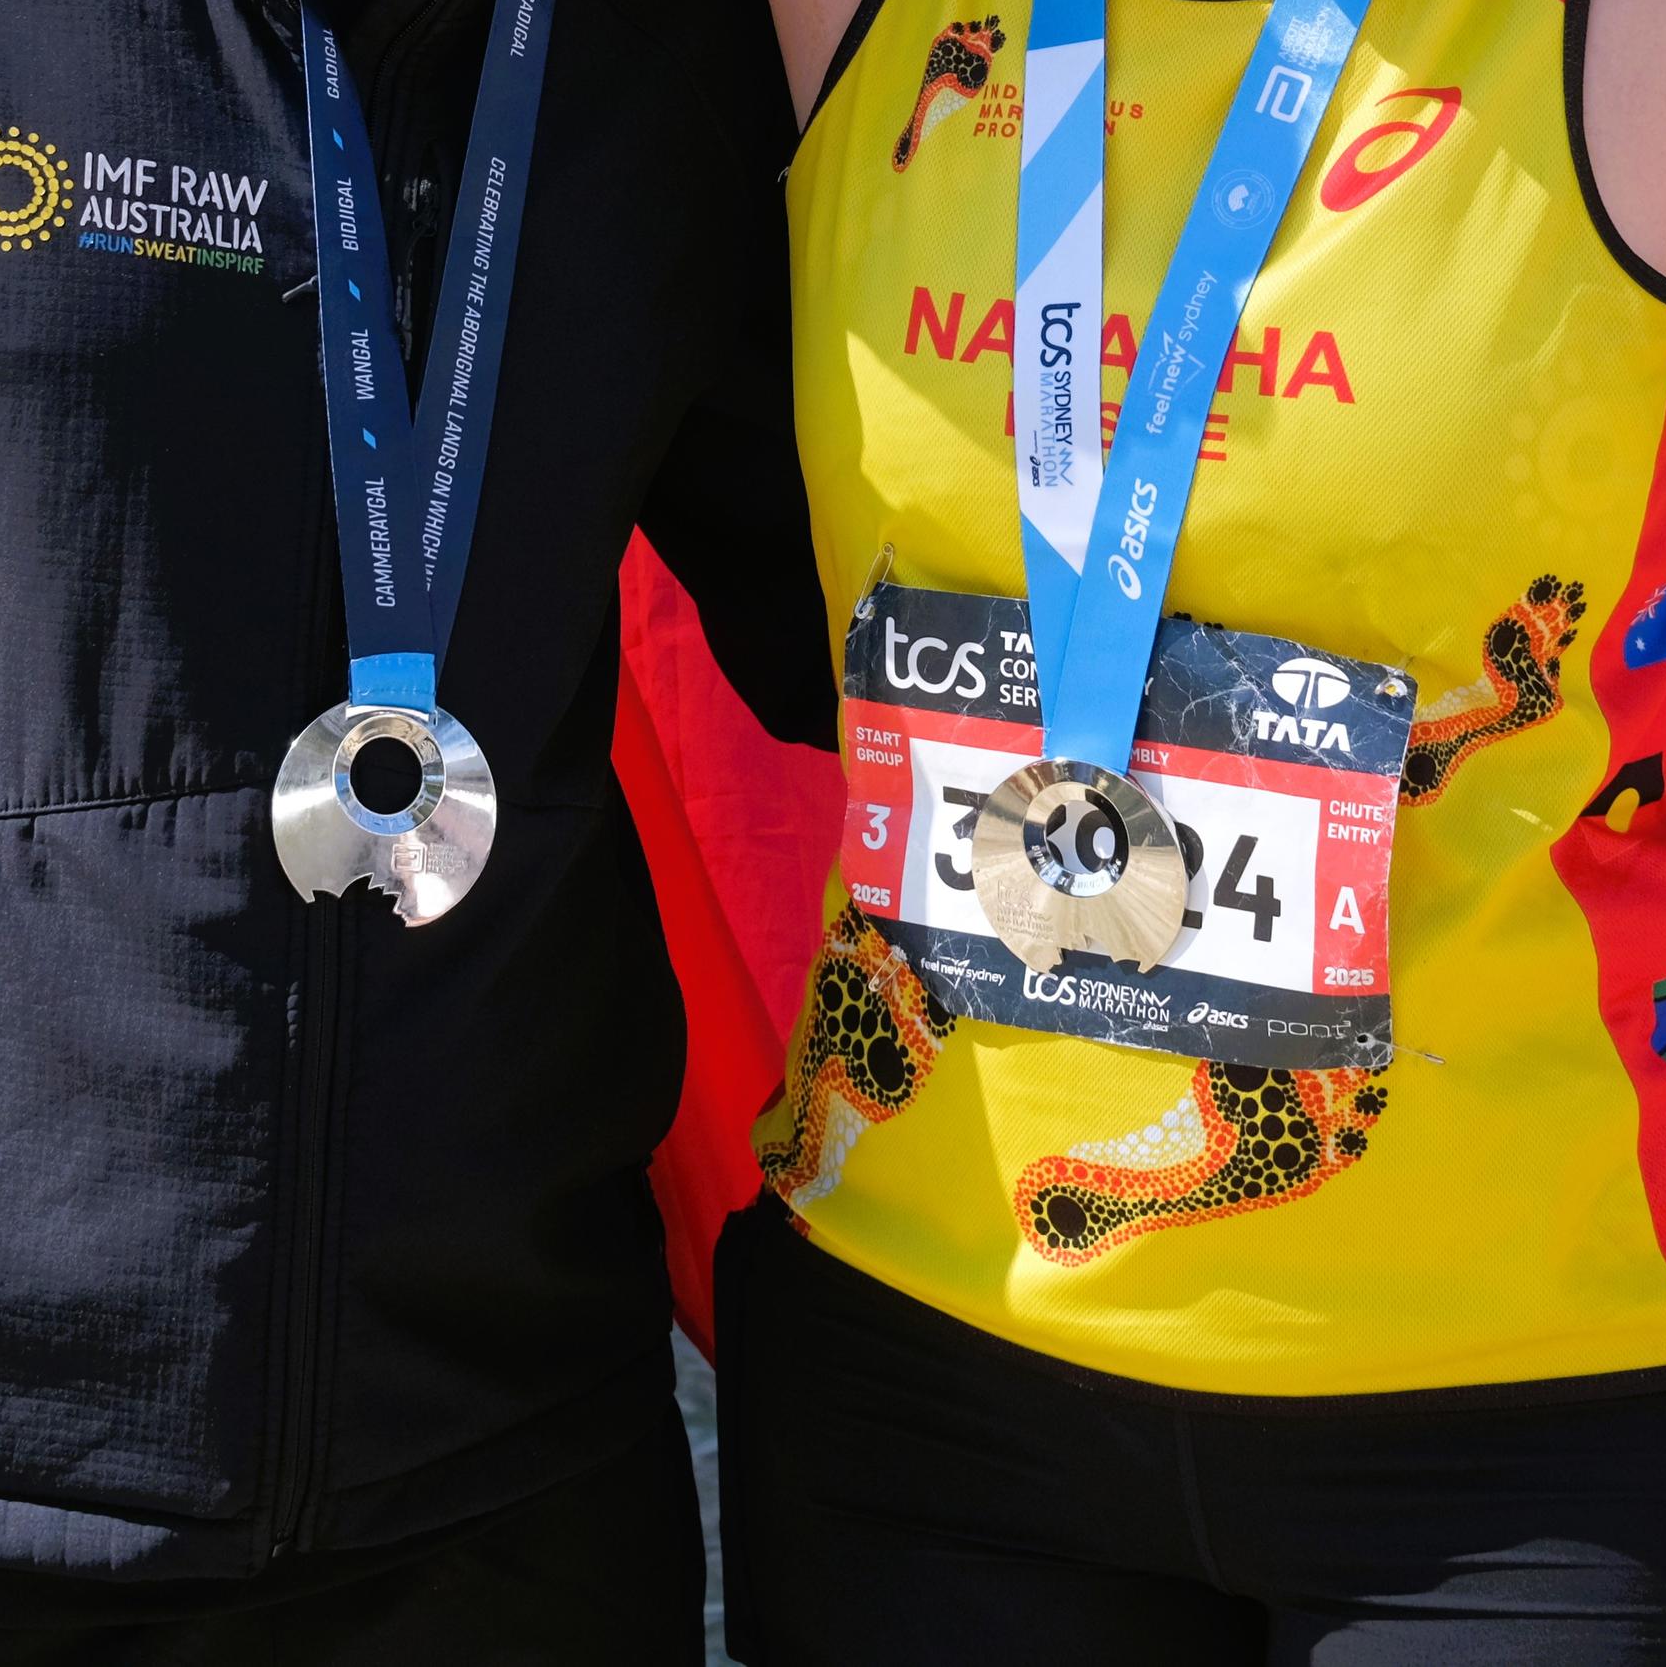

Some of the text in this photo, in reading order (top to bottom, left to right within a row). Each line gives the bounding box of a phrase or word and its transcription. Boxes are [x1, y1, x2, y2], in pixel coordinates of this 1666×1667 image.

[83, 152, 269, 215] IMF RAW
[80, 195, 264, 254] AUSTRALIA
[337, 177, 359, 251] BIDJIGAL
[473, 156, 506, 270] CELEBRATING
[78, 231, 265, 275] #RUNSWEATINSPIRE
[466, 272, 488, 306] THE
[449, 305, 483, 410] ABORIGINAL
[1040, 302, 1082, 368] tcs
[1145, 270, 1218, 435] feel new sydney
[351, 328, 375, 400] WANGAL
[1040, 372, 1058, 487] MARATHON
[1054, 370, 1073, 445] SYDNEY
[438, 410, 464, 470] LANDS
[432, 471, 453, 498] ON
[365, 477, 396, 607] CAMMERAYGAL
[422, 500, 448, 561] WHICH
[1119, 477, 1158, 560] asics
[886, 616, 986, 699] tcs
[855, 726, 901, 747] START
[1252, 711, 1351, 752] TATA
[856, 747, 904, 767] GROUP
[862, 804, 891, 850] 3
[1327, 822, 1382, 845] ENTRY
[1329, 800, 1384, 822] CHUTE
[852, 882, 891, 908] 2025
[1329, 886, 1365, 934] A
[920, 957, 1006, 986] feel new sydney
[1079, 978, 1141, 1002] SYDNEY
[1324, 965, 1375, 986] 2025
[1078, 995, 1170, 1022] MARATHON
[1207, 1008, 1249, 1029] asics
